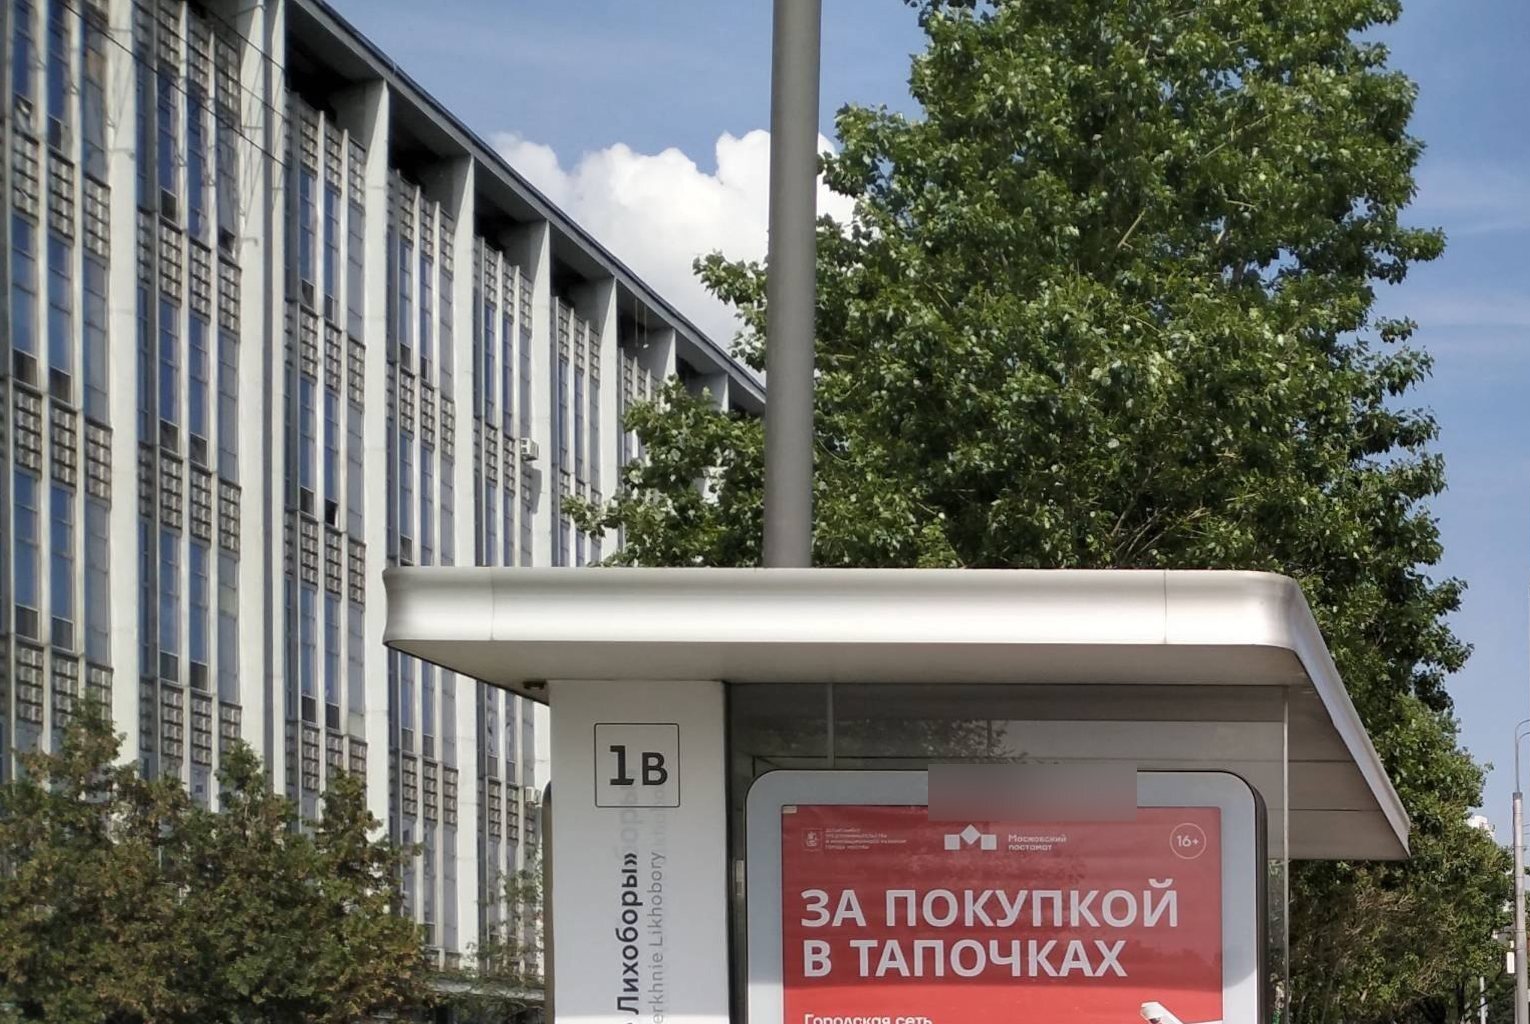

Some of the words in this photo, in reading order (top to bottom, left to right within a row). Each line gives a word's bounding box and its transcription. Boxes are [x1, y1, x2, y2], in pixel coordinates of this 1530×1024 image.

[1177, 835, 1200, 847] 16+
[647, 852, 666, 946] Likhobory
[801, 889, 866, 928] ЗА
[886, 877, 1178, 928] ПОКУПКОЙ
[615, 852, 643, 1015] Лихоборы»
[803, 939, 832, 977] В
[850, 939, 1128, 977] ТАПОЧКАХ
